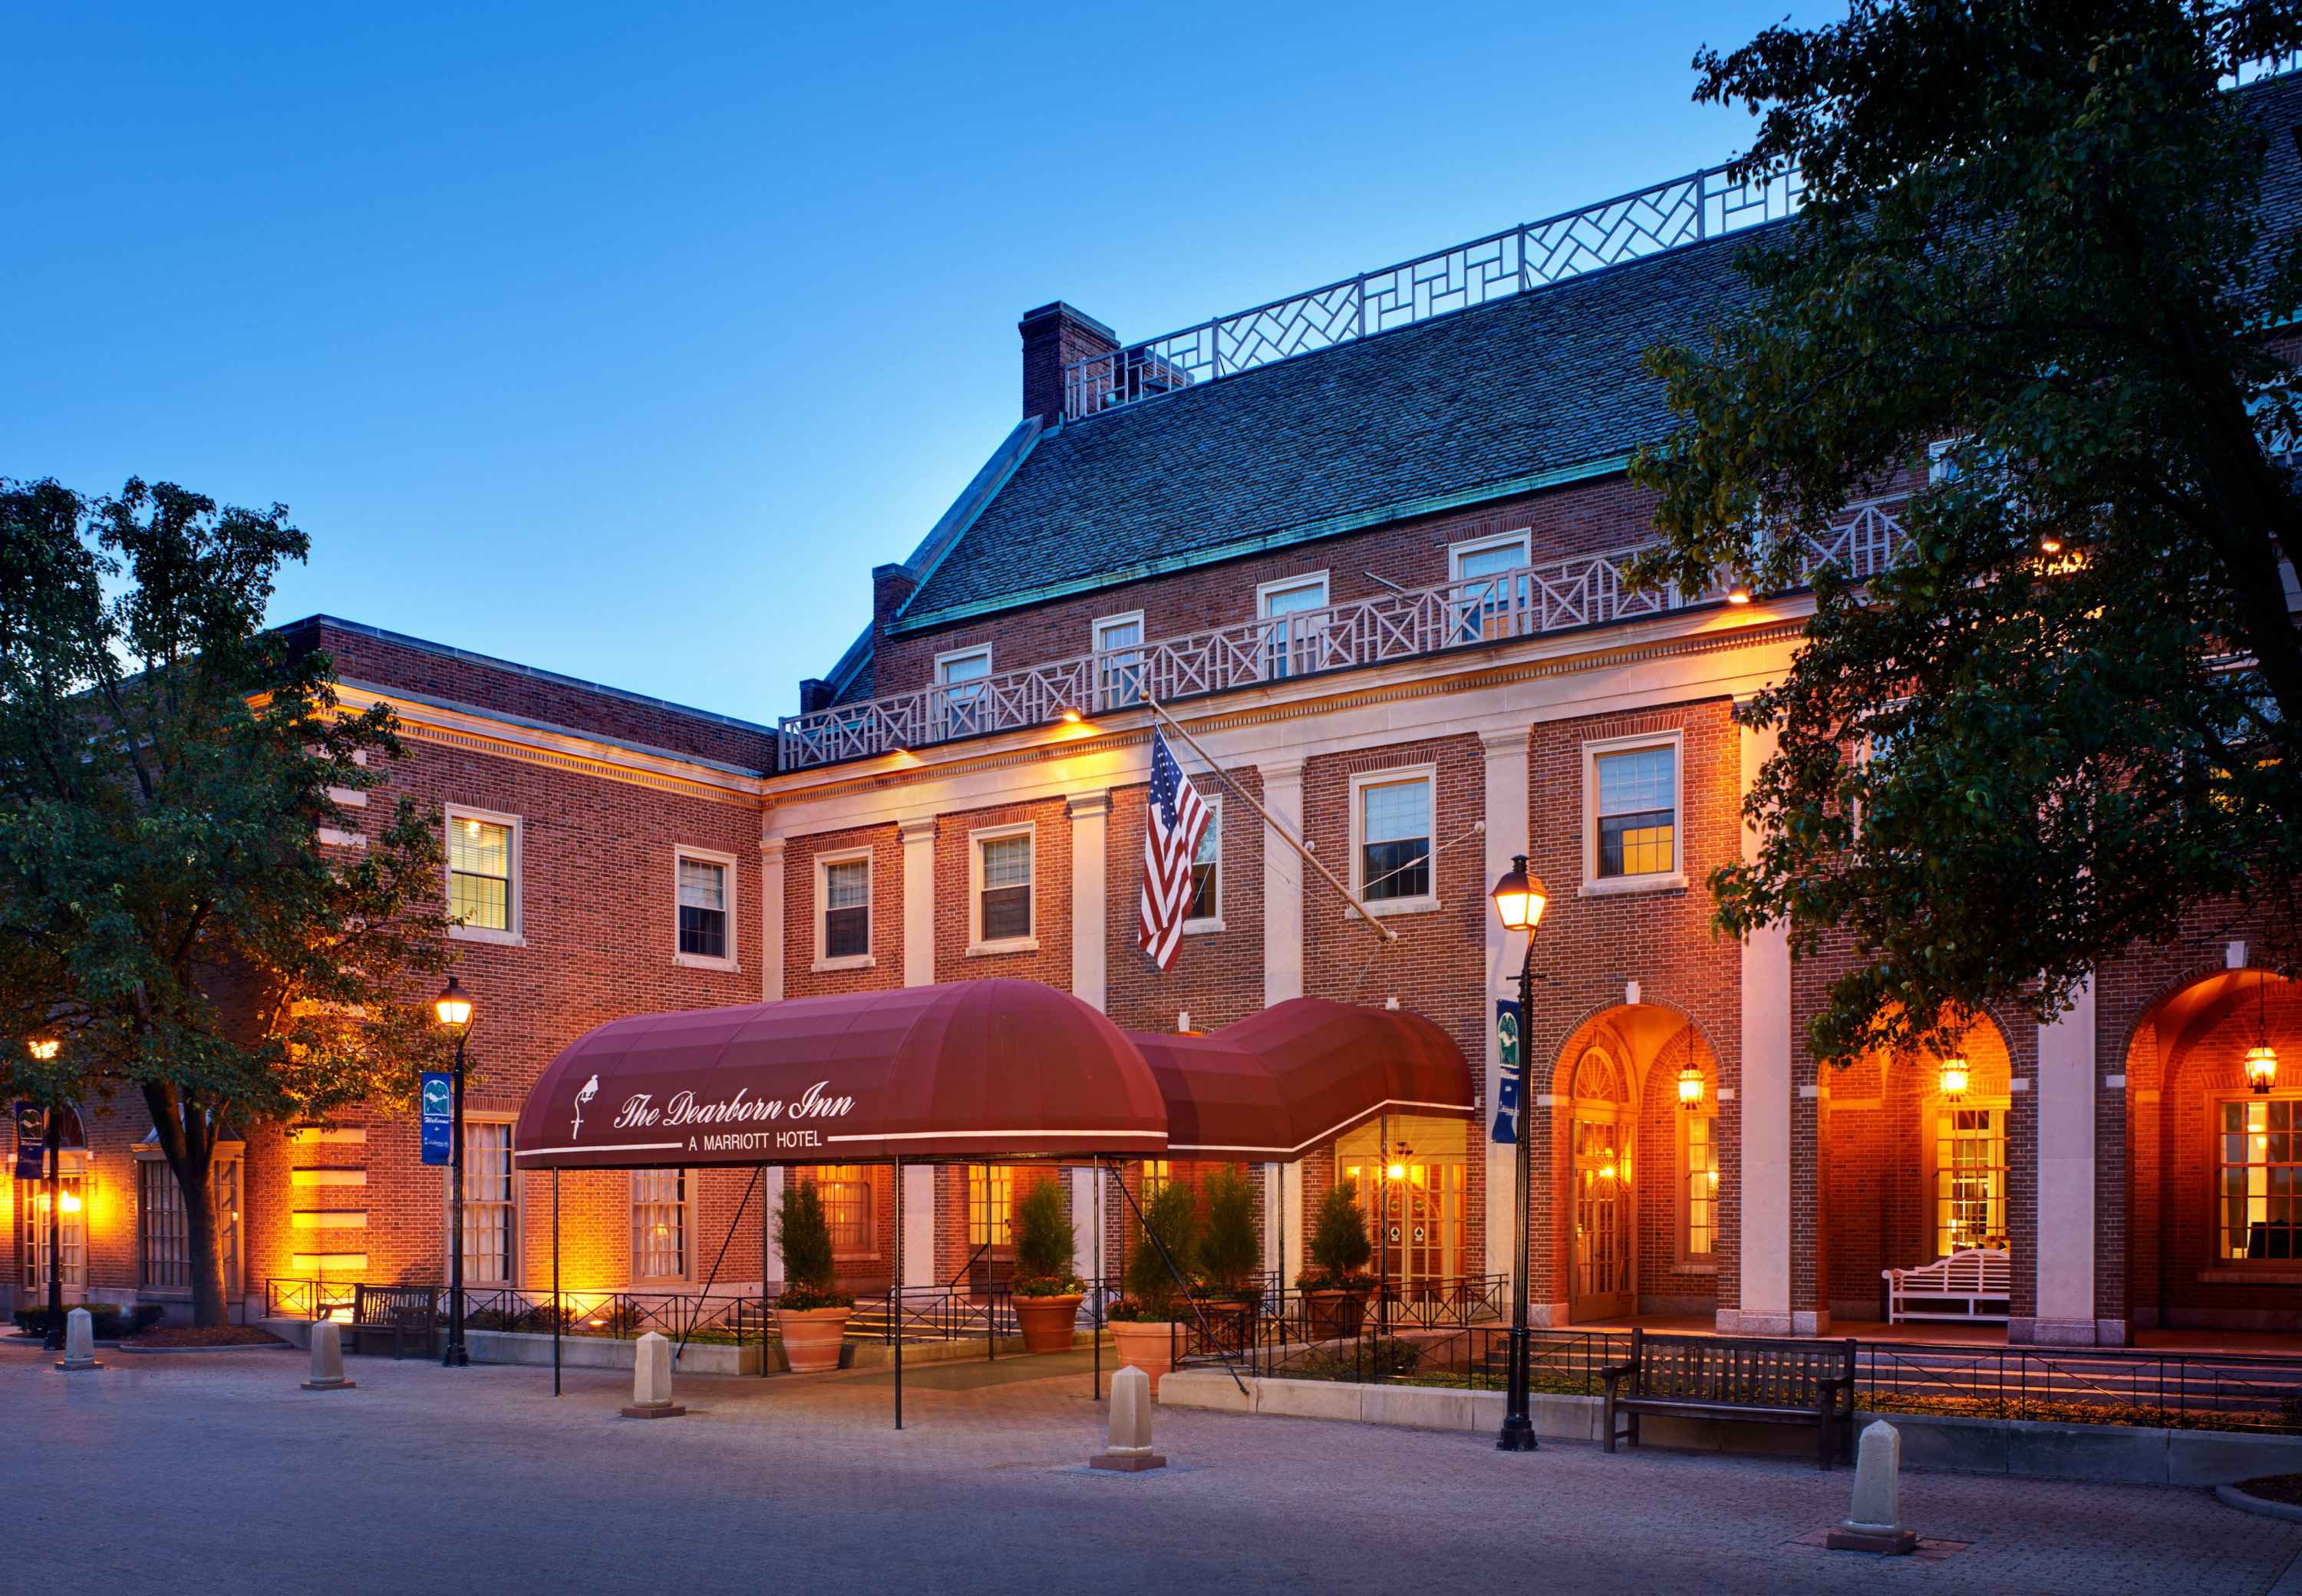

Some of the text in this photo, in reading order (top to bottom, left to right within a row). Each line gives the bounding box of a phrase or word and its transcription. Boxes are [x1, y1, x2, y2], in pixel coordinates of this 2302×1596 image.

[614, 1080, 856, 1128] The Dearborn Inn
[688, 1130, 822, 1151] A MARRIOTT HOTEL
